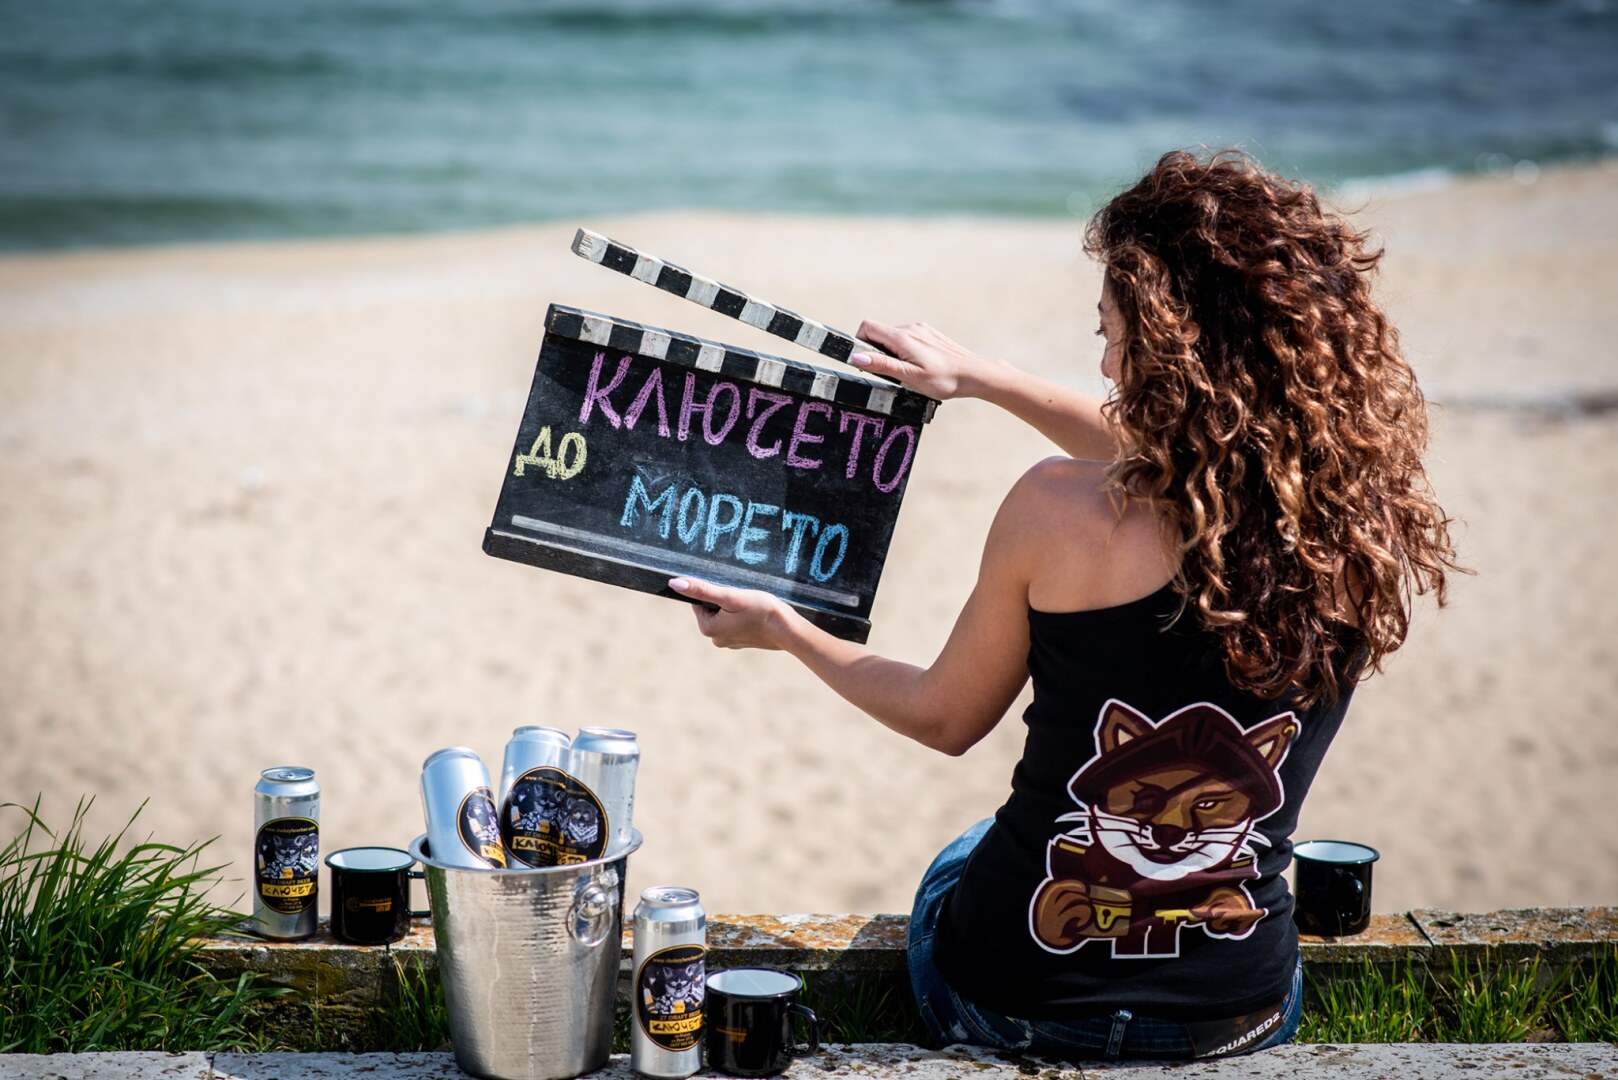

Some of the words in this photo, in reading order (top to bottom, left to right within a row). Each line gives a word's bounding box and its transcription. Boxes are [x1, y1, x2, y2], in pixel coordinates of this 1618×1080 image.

[513, 424, 589, 480] ДО
[620, 475, 850, 583] МОРЕТО
[1196, 1011, 1281, 1059] SQUARED2
